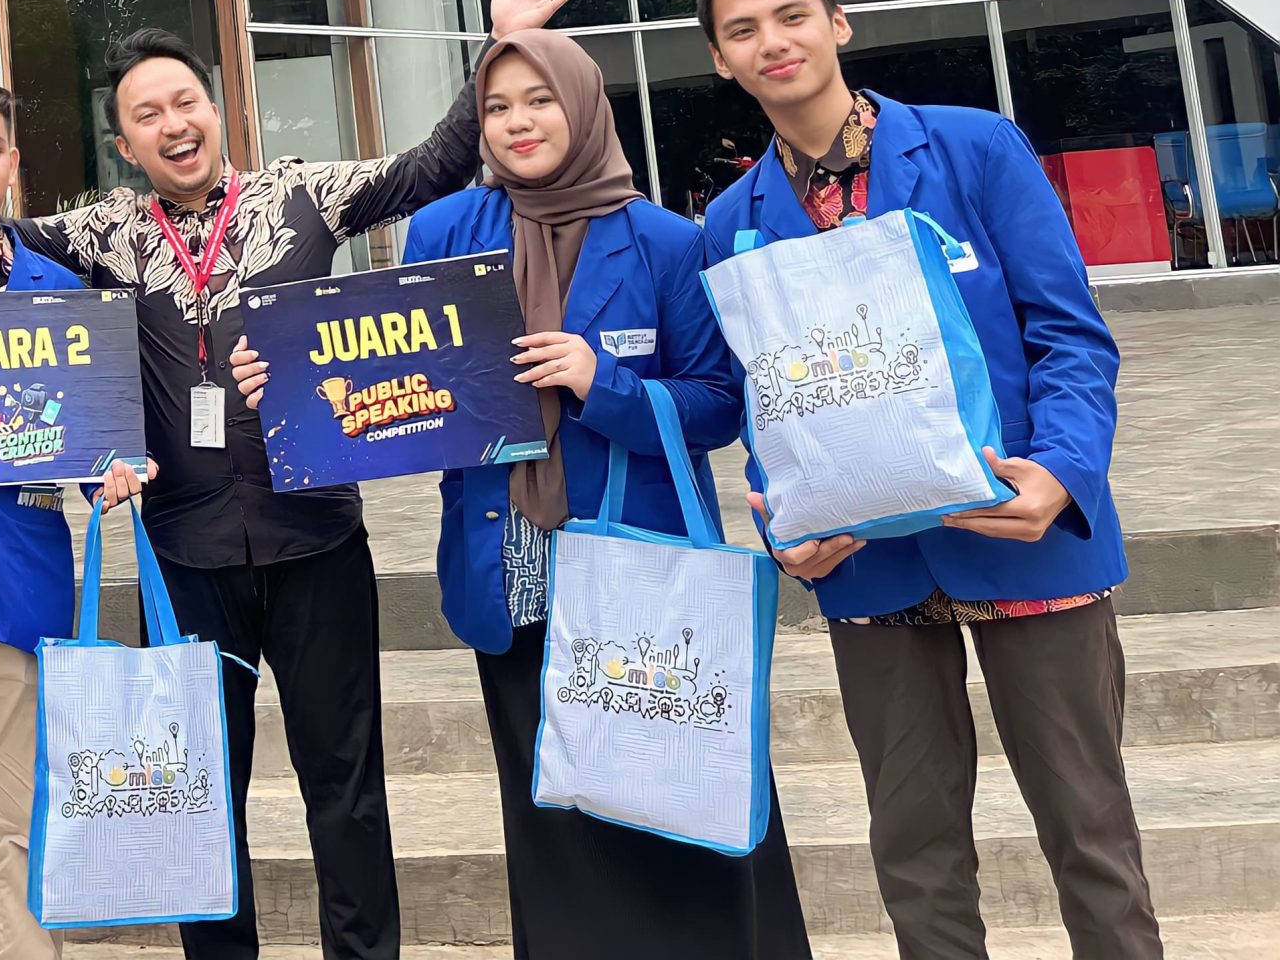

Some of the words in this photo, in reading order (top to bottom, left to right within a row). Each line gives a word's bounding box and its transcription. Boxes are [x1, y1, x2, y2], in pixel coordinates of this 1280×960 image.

[65, 324, 92, 366] 2
[308, 308, 438, 366] JUARA
[442, 304, 464, 348] 1
[341, 389, 452, 434] SPEAKING
[349, 373, 428, 413] PUBLIC
[0, 439, 65, 461] CREATOR
[366, 417, 444, 442] COMPETITION
